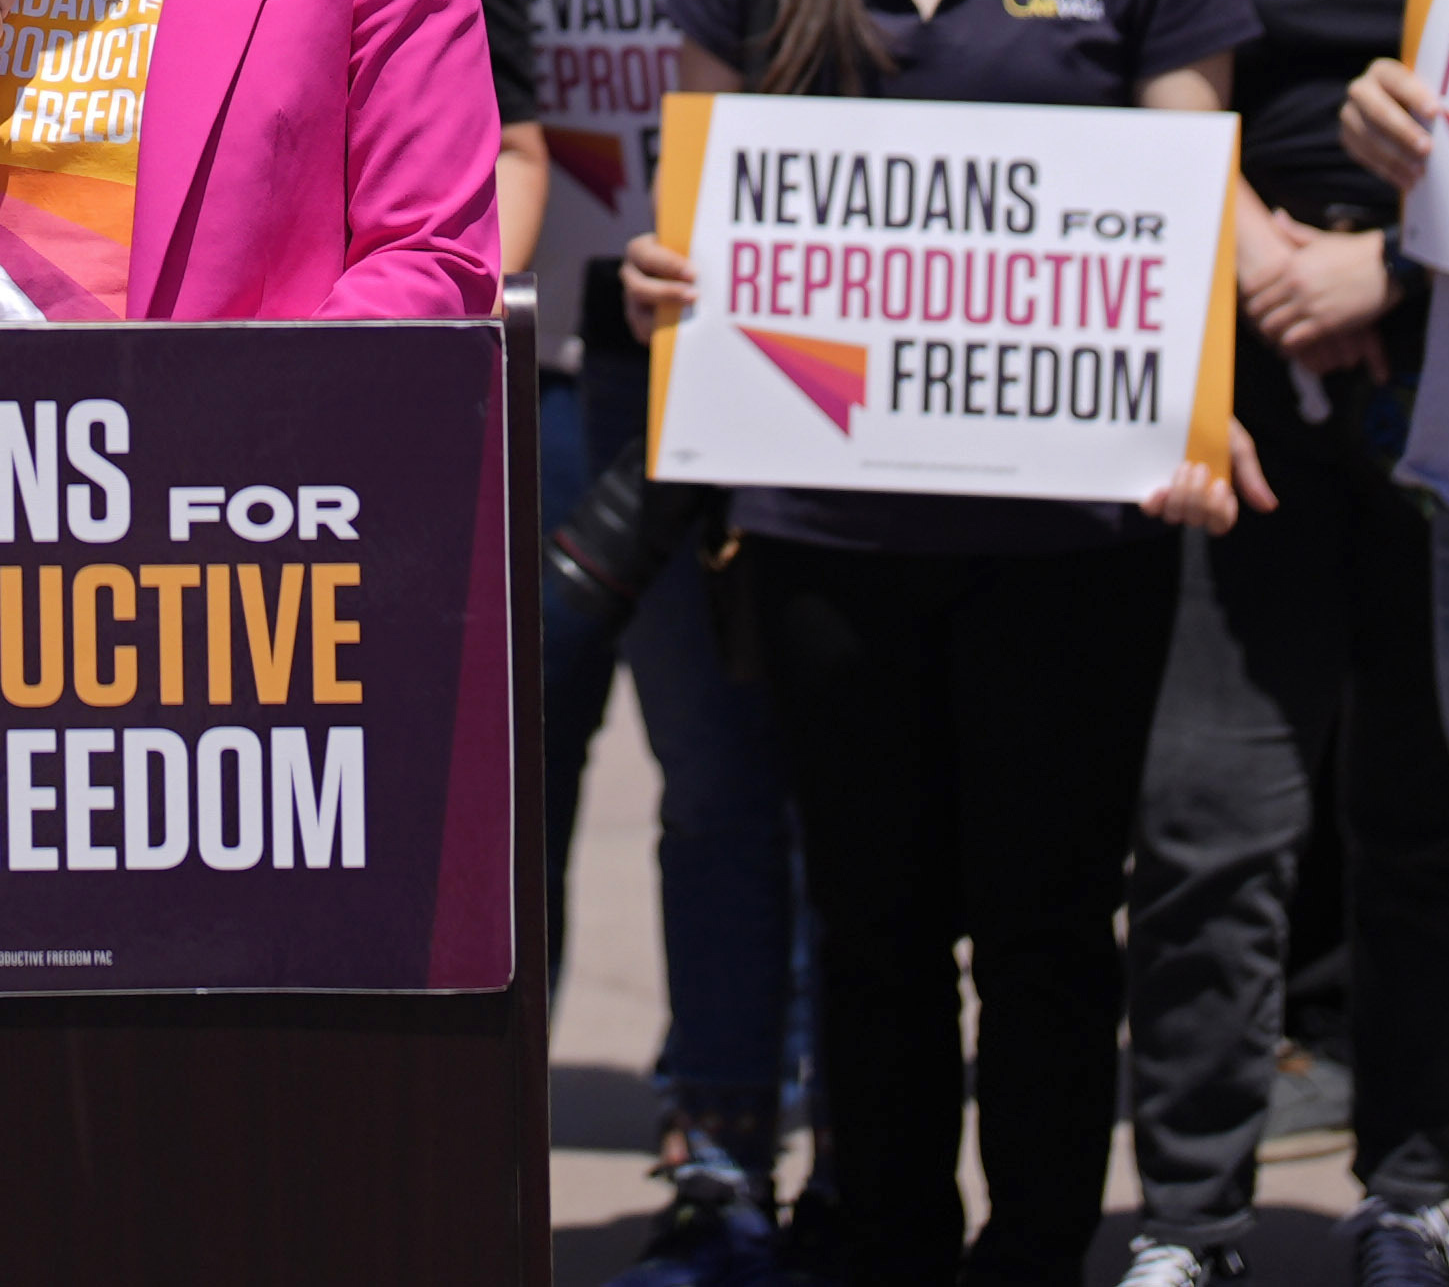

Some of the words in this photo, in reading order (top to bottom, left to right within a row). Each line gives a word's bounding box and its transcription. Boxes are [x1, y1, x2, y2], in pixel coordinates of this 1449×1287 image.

[733, 148, 1038, 236] NEVADANS
[1060, 211, 1165, 240] FOR
[728, 240, 1163, 333] REPRODUCTIVE
[890, 337, 1161, 425] FREEDOM
[169, 485, 361, 542] FOR
[47, 950, 92, 966] FREEDOM
[94, 950, 113, 966] PAC
